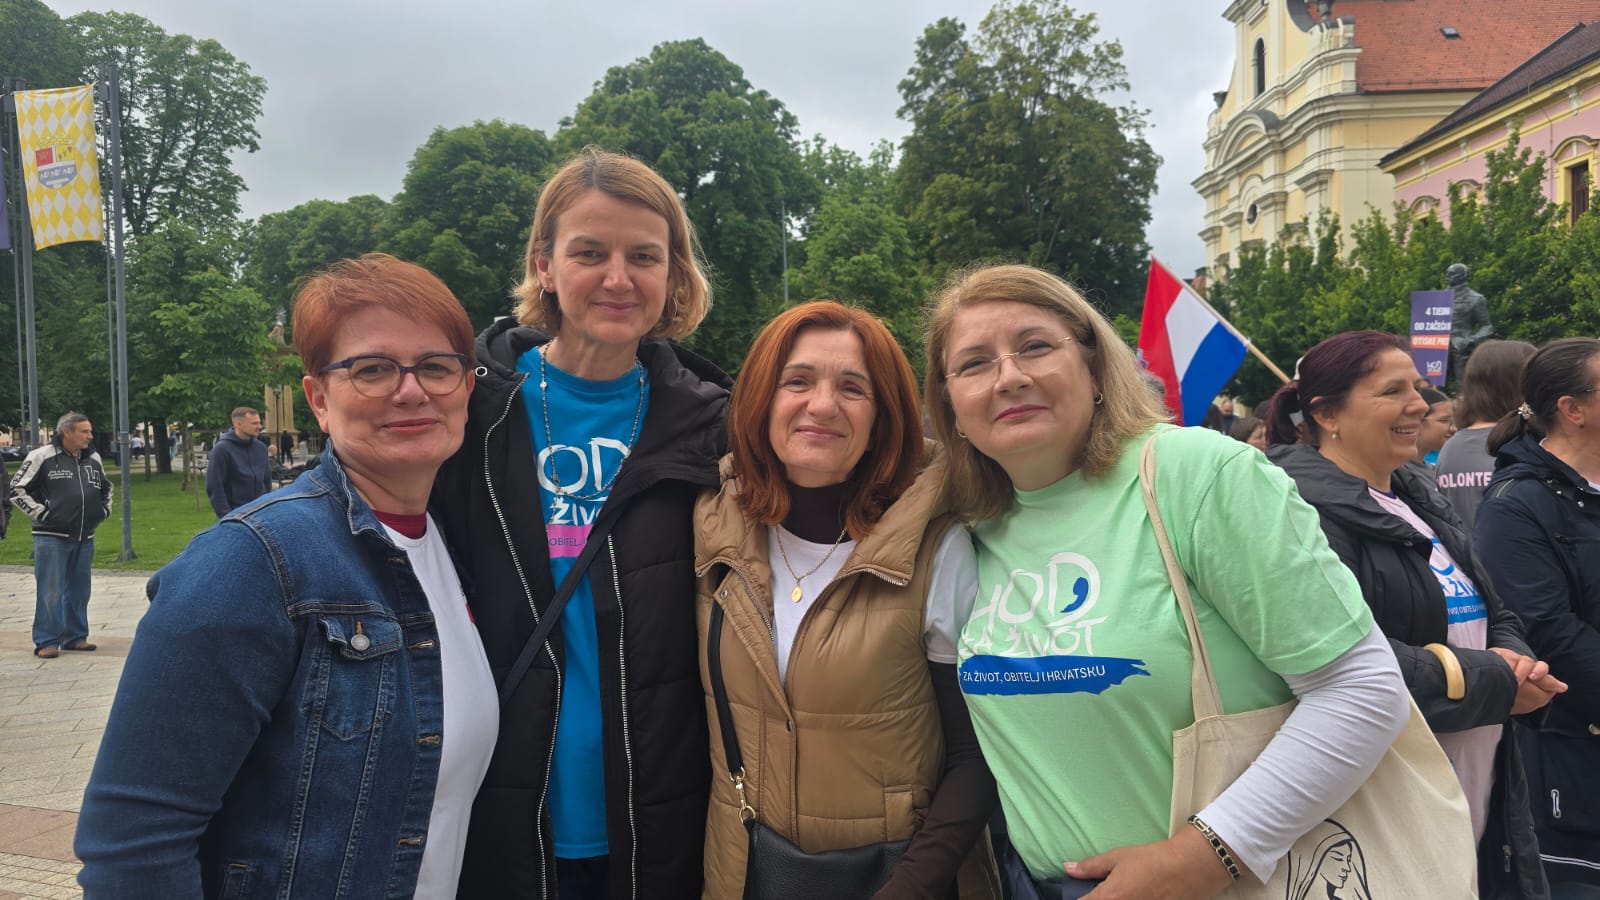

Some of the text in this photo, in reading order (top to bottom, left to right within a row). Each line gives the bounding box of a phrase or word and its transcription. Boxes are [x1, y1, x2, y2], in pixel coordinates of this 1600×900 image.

[1425, 307, 1431, 316] 4
[538, 437, 631, 501] OD
[1437, 471, 1493, 488] OLONTE
[549, 497, 601, 526] ŽIV
[1000, 615, 1109, 658] ŽIVOT
[963, 671, 973, 681] ZA
[974, 669, 1003, 684] ŽIVOT,
[1003, 671, 1040, 682] OBITELJ
[1046, 664, 1106, 681] HRVATSKU
